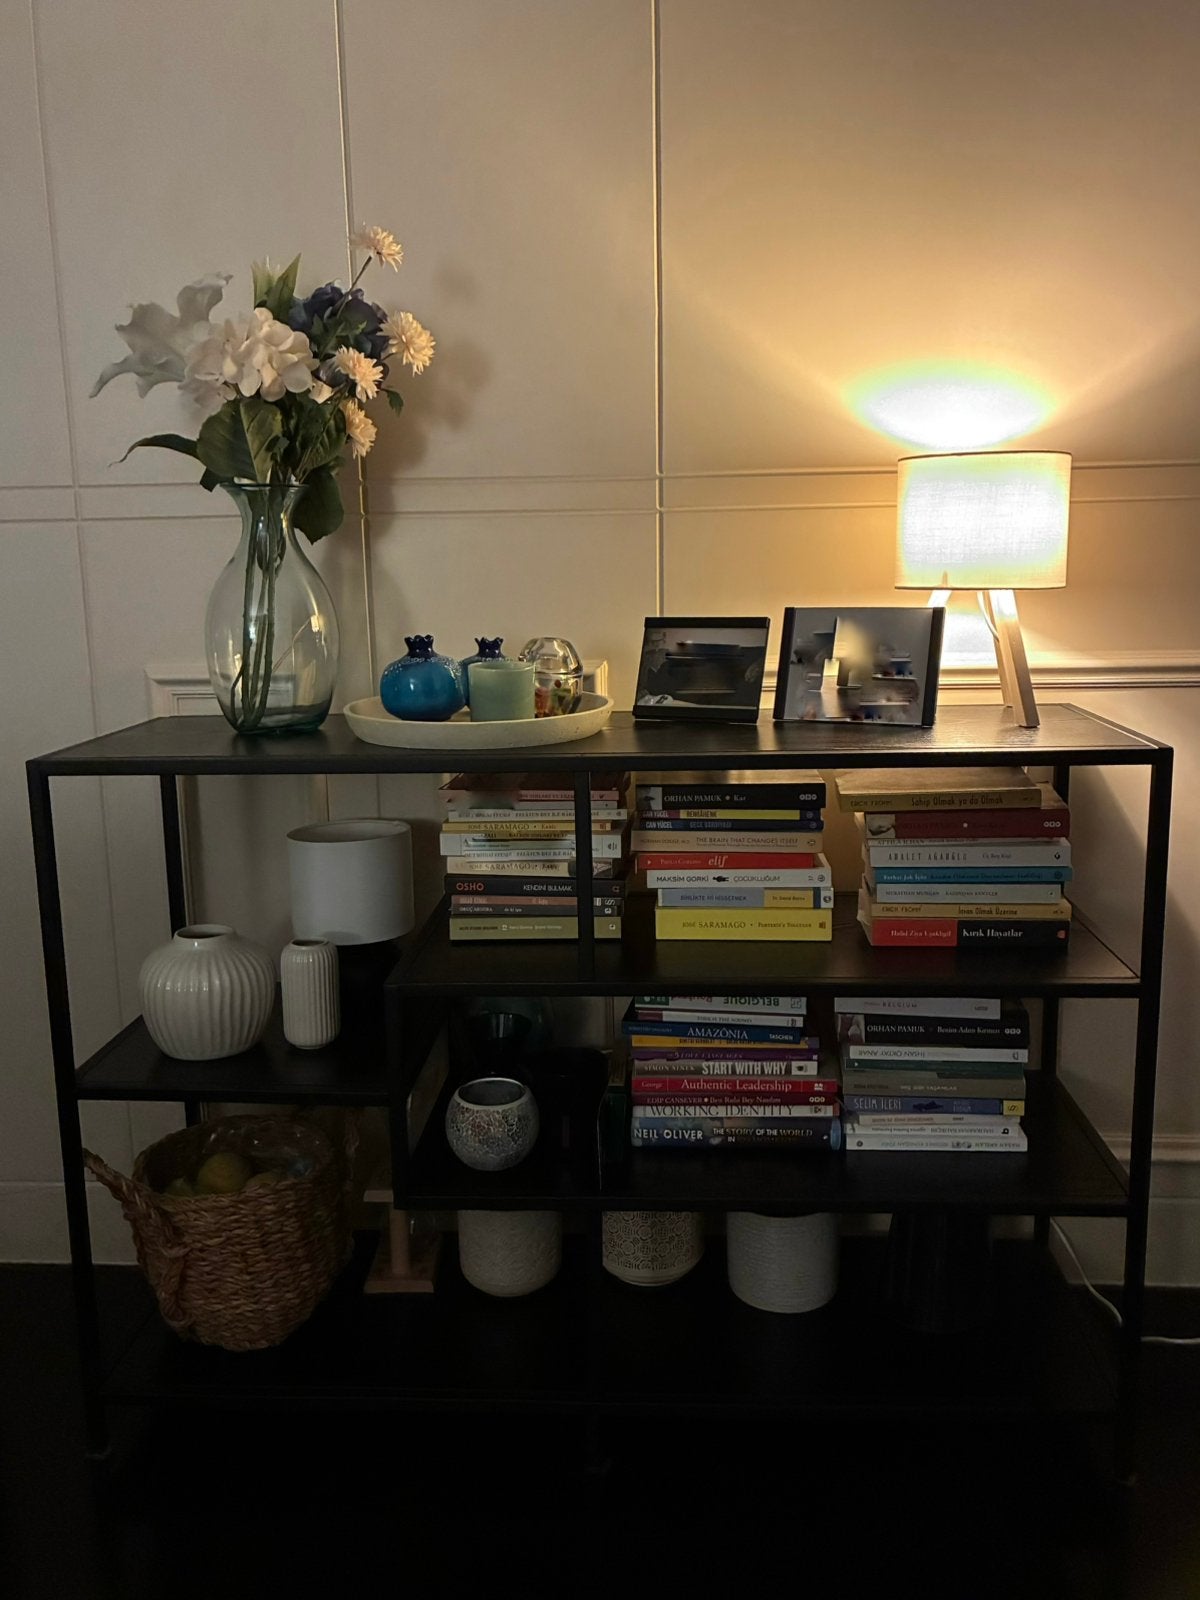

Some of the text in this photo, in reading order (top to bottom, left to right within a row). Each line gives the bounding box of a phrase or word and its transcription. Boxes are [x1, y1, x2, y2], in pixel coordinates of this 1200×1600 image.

[664, 794, 692, 802] ORHAN
[694, 794, 722, 802] PAMUK
[932, 795, 955, 806] Olmak
[957, 798, 967, 807] ya
[969, 796, 978, 805] da
[981, 795, 1003, 805] Olmak
[483, 822, 529, 831] SARAMAGO
[645, 821, 657, 829] CAN
[657, 820, 672, 829] YÜCEL
[708, 855, 728, 868] elif
[888, 852, 922, 861] ADALET
[456, 882, 485, 892] OSHO
[547, 884, 572, 892] BULMAK
[698, 920, 747, 929] SARAMAGO
[986, 928, 1024, 940] Hayatlar
[687, 1026, 794, 1041] AMAZÔNIA TASCHEN
[867, 1024, 896, 1033] ORHAN
[898, 1024, 925, 1034] PAMUK
[702, 1061, 733, 1075] START
[735, 1061, 762, 1075] WITH
[764, 1061, 787, 1076] WHY
[681, 1079, 732, 1090] Authentic
[736, 1080, 792, 1092] Leadership
[651, 1105, 795, 1117] WORKING IDENTITY
[633, 1128, 704, 1141] NEIL OLIVER
[725, 1128, 754, 1136] STORY
[779, 1129, 814, 1137] WORLD
